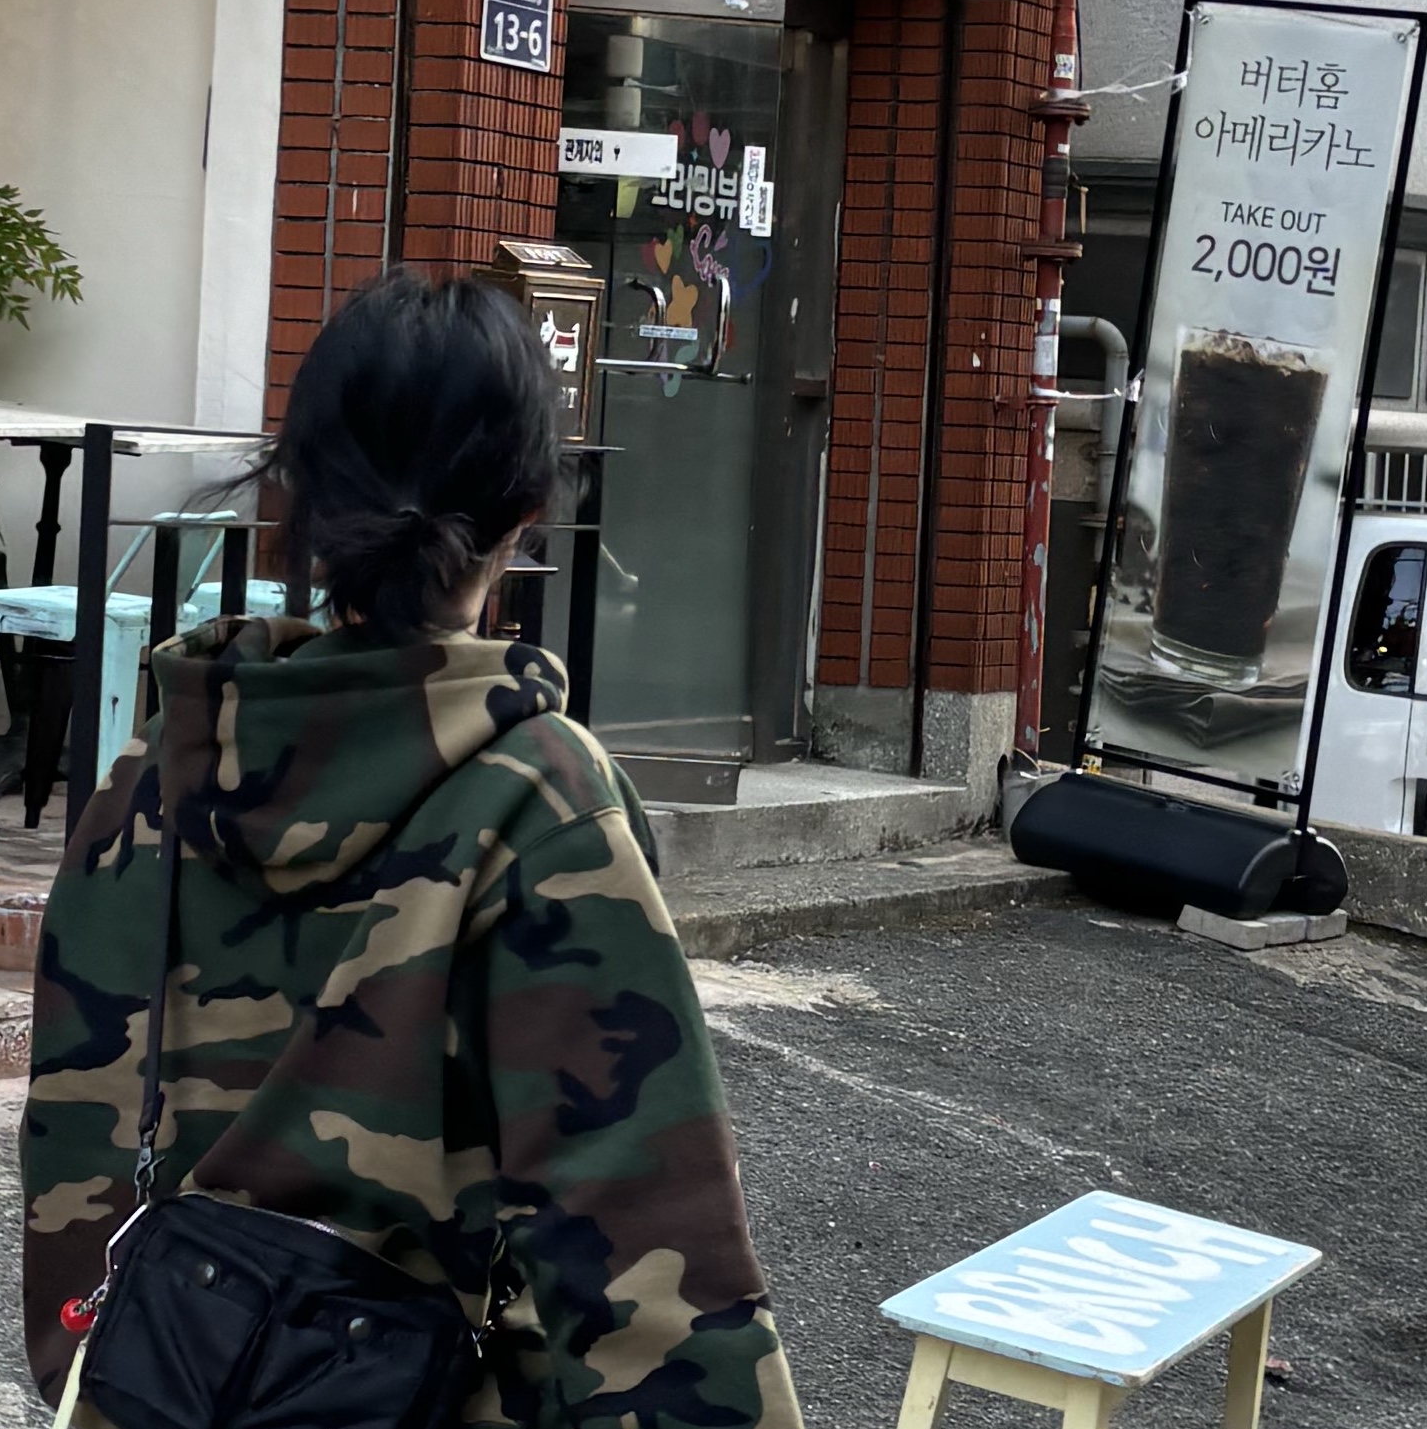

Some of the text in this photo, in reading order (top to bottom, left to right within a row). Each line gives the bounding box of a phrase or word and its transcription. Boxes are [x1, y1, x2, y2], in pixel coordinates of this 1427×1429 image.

[494, 12, 542, 56] 13-6
[1240, 56, 1349, 110] 버터홈
[1195, 110, 1376, 172] 아메리카노
[1222, 201, 1327, 234] TAKE OUT
[1191, 234, 1341, 297] 2,000원
